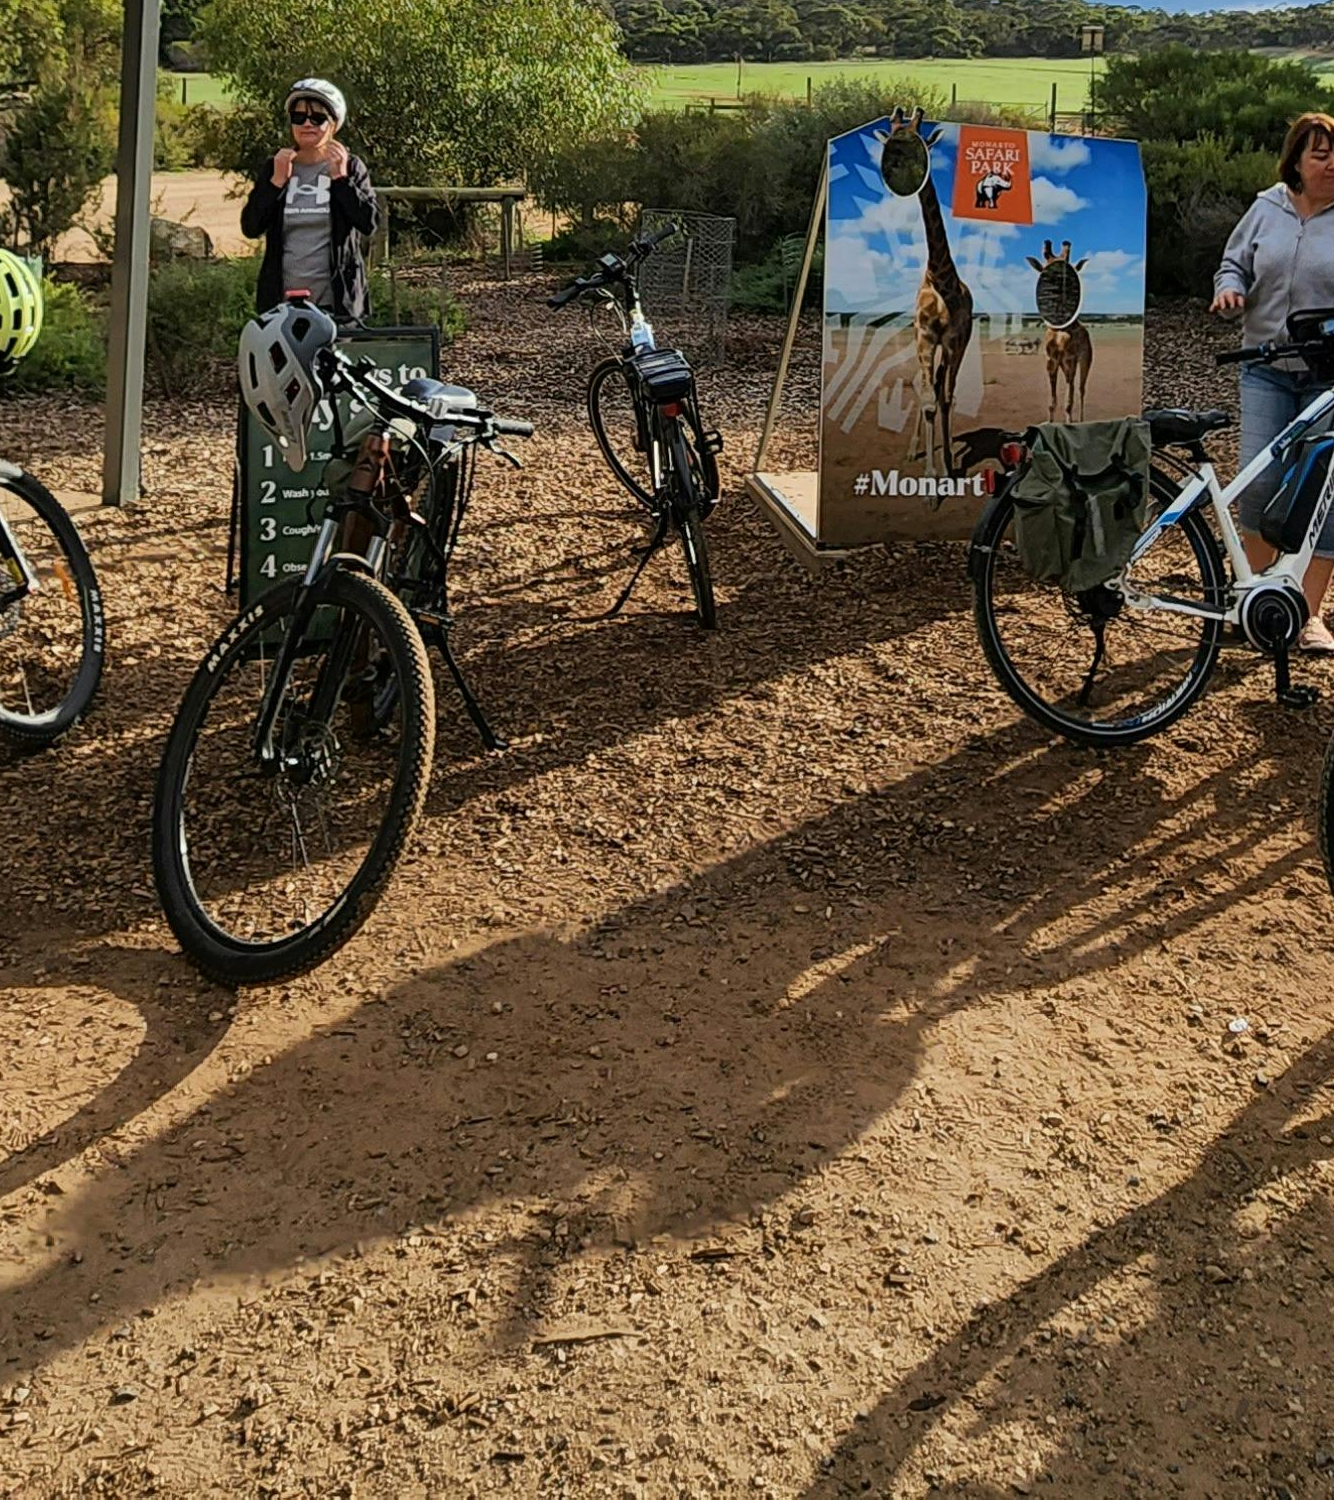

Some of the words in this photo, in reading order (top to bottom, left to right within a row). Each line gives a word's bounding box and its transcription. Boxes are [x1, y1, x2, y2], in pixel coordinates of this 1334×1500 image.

[965, 147, 1020, 162] SAFARI
[971, 160, 1015, 176] PARK
[262, 444, 273, 468] 1
[260, 480, 276, 504] 2
[282, 487, 309, 499] Wash
[853, 469, 986, 497] #Monart
[259, 517, 277, 541] 3
[259, 554, 277, 579] 4
[282, 563, 308, 573] Obse
[207, 604, 264, 673] MAXXIS
